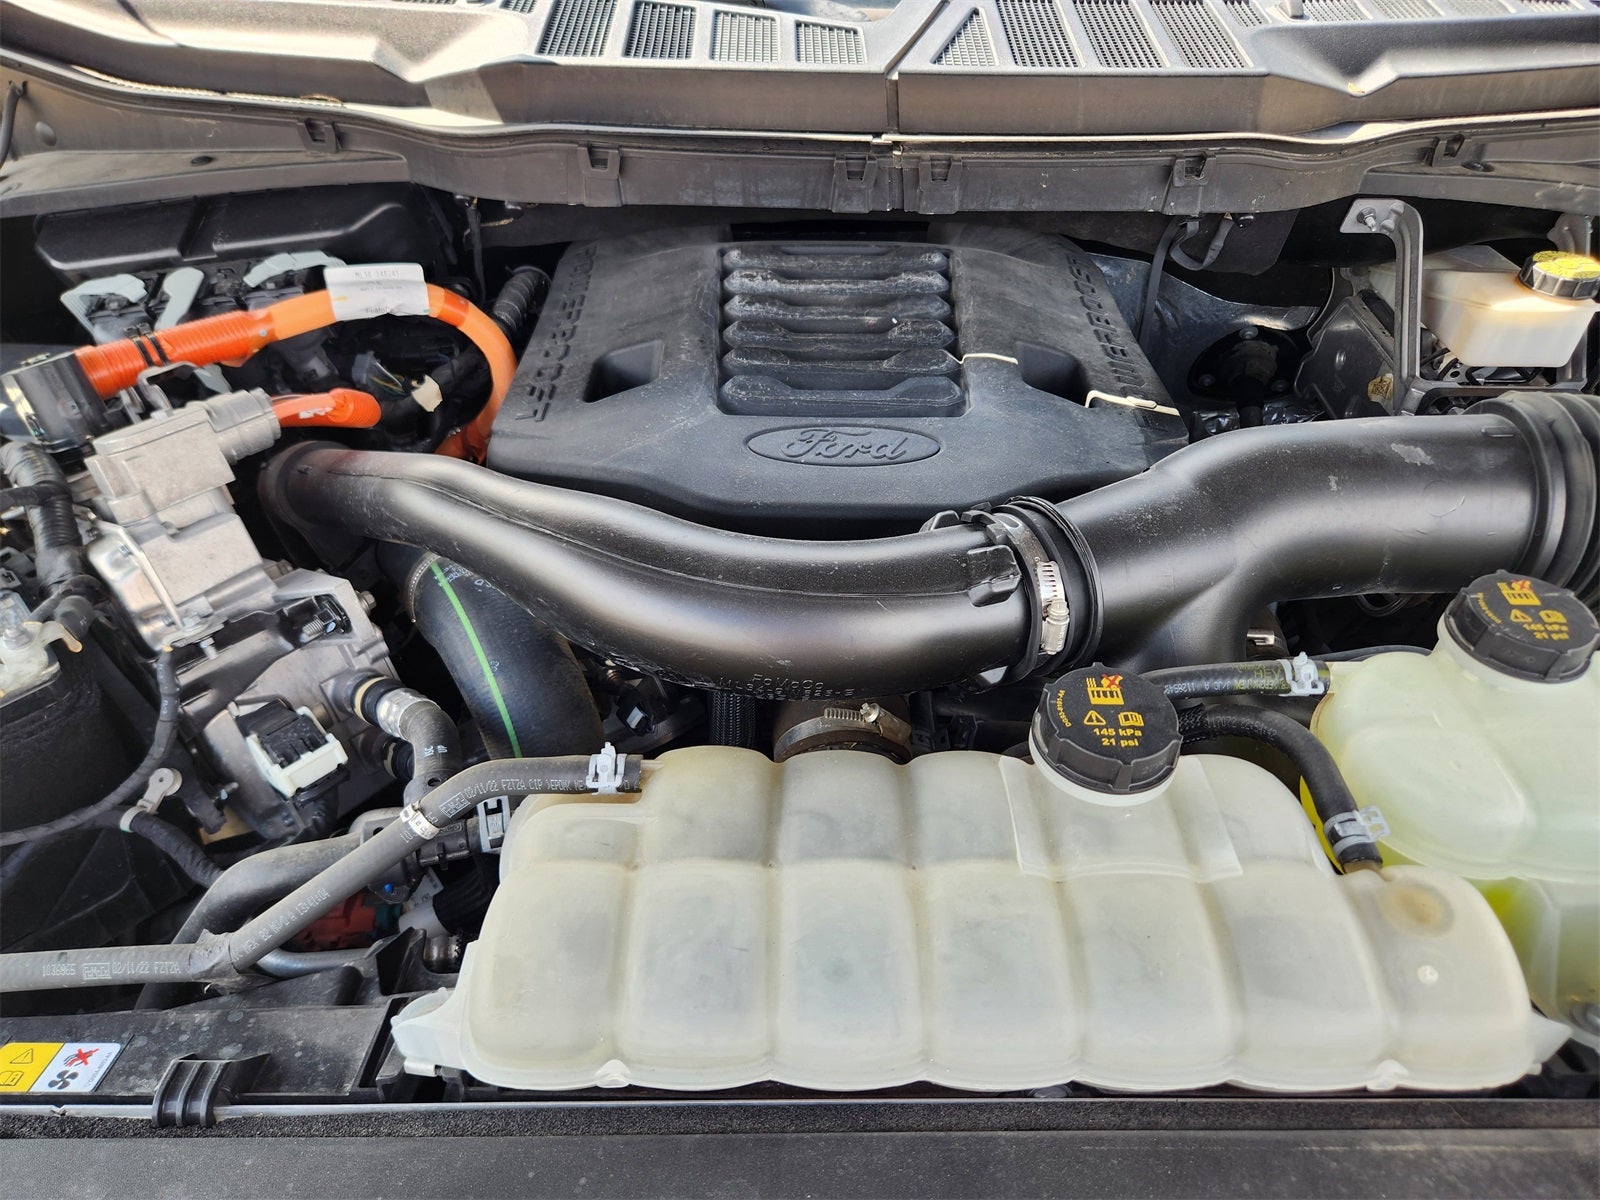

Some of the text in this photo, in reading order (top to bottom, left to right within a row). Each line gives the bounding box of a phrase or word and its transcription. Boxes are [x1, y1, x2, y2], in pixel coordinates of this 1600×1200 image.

[779, 428, 908, 461] Ford
[1093, 727, 1142, 737] 145 kPa
[1101, 738, 1139, 748] 21 psi
[112, 960, 151, 975] 02/11/22
